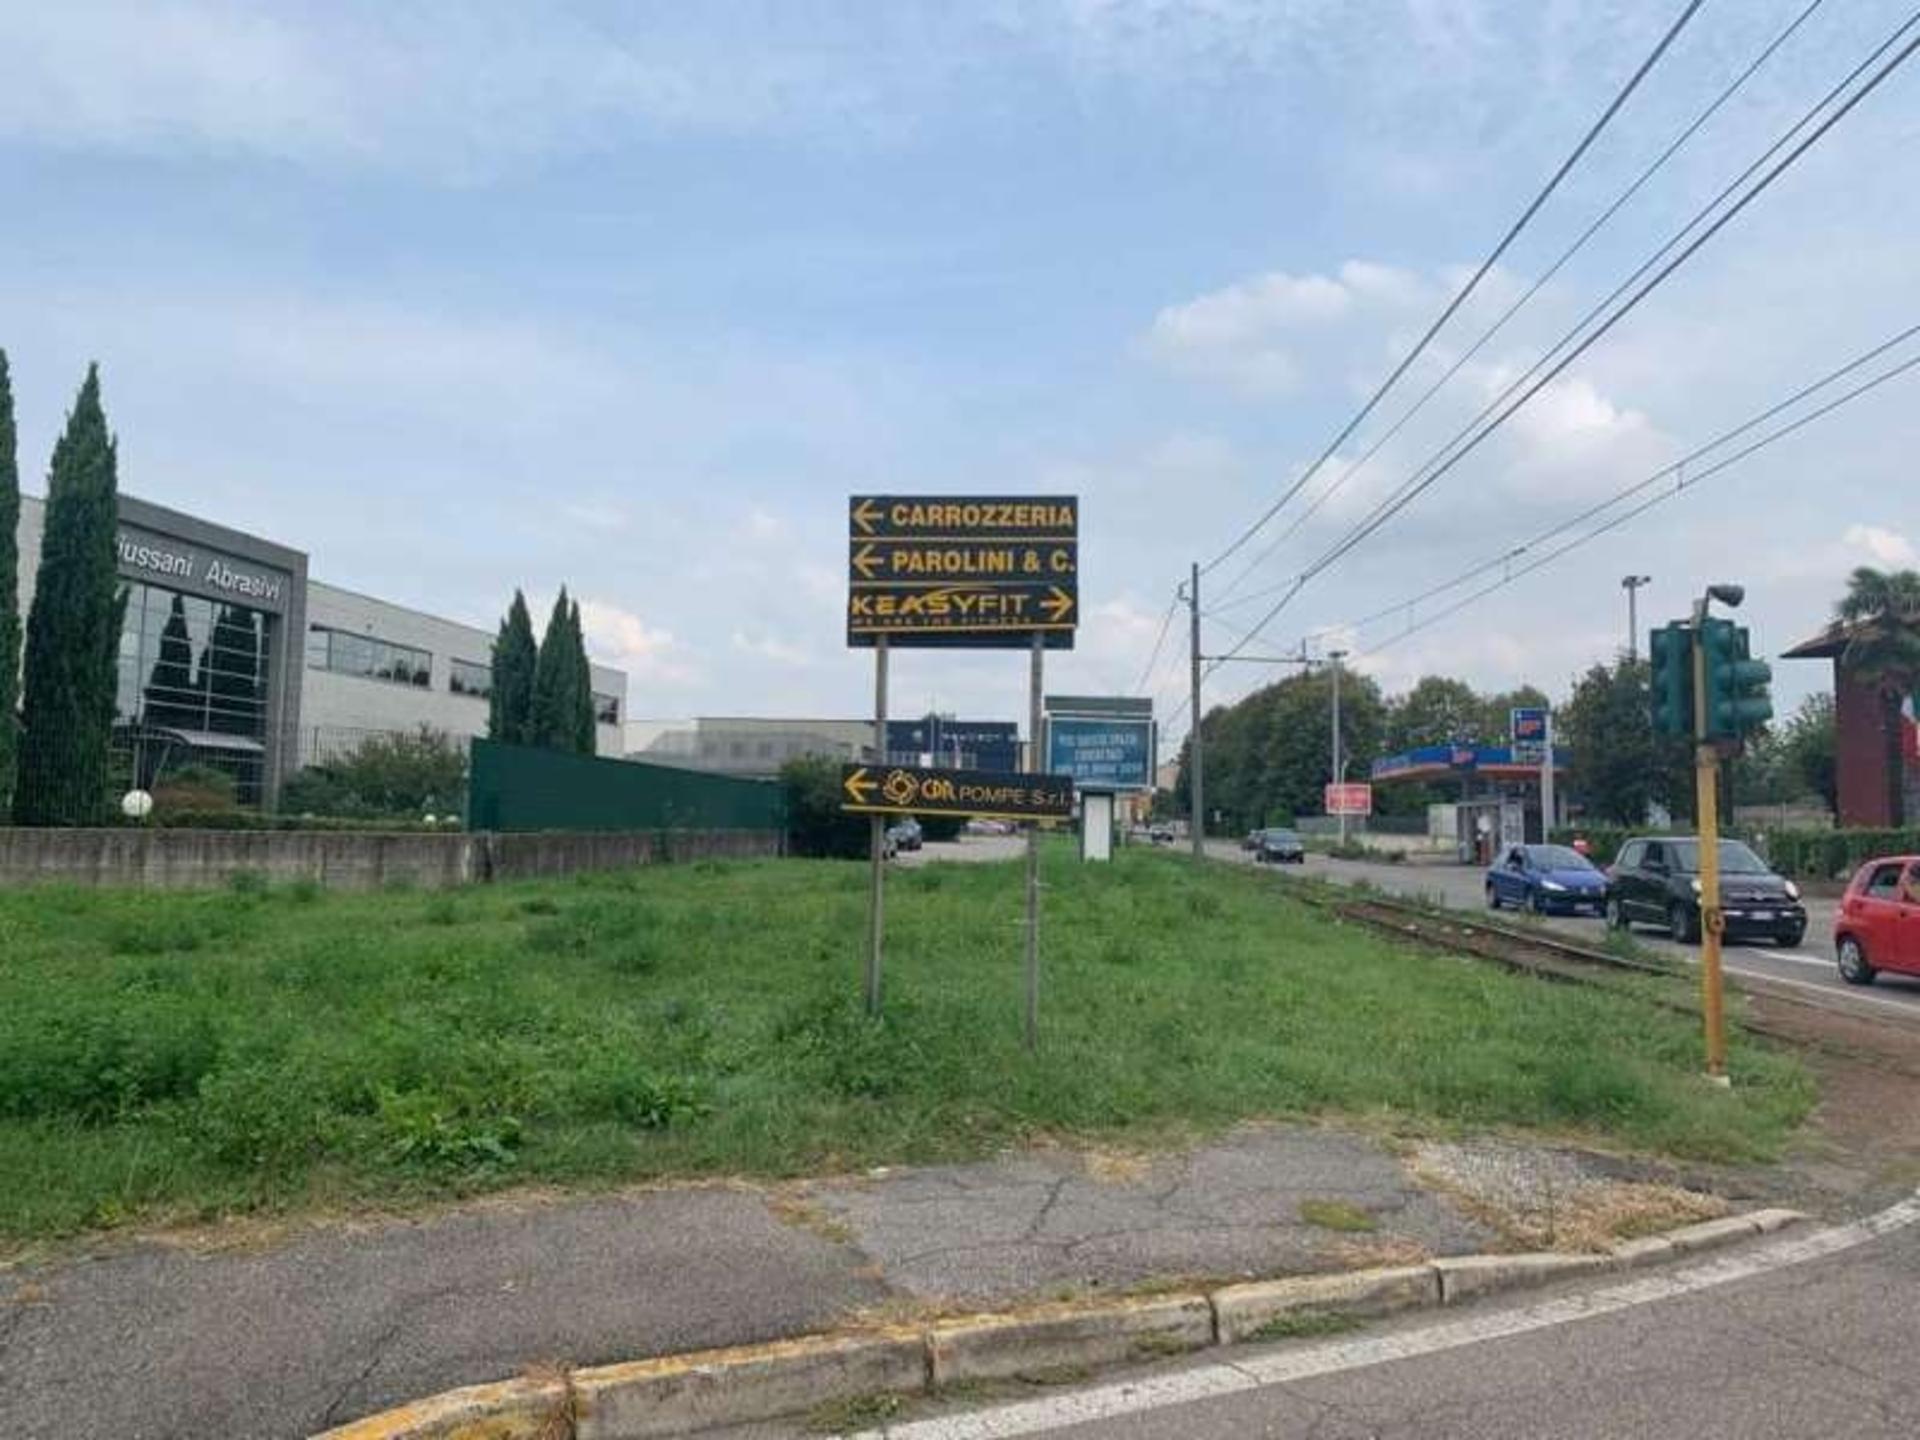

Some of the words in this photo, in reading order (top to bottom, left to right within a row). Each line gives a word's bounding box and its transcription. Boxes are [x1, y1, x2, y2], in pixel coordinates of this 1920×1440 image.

[891, 504, 1074, 527] CARROZZERIA
[115, 534, 193, 577] iussani
[206, 559, 283, 599] Abrasivi
[892, 550, 1014, 573] PAROLINI
[1023, 550, 1040, 573] &
[1051, 550, 1076, 573] C.
[851, 592, 1030, 616] KEASYFIT
[959, 785, 1027, 805] POMPE
